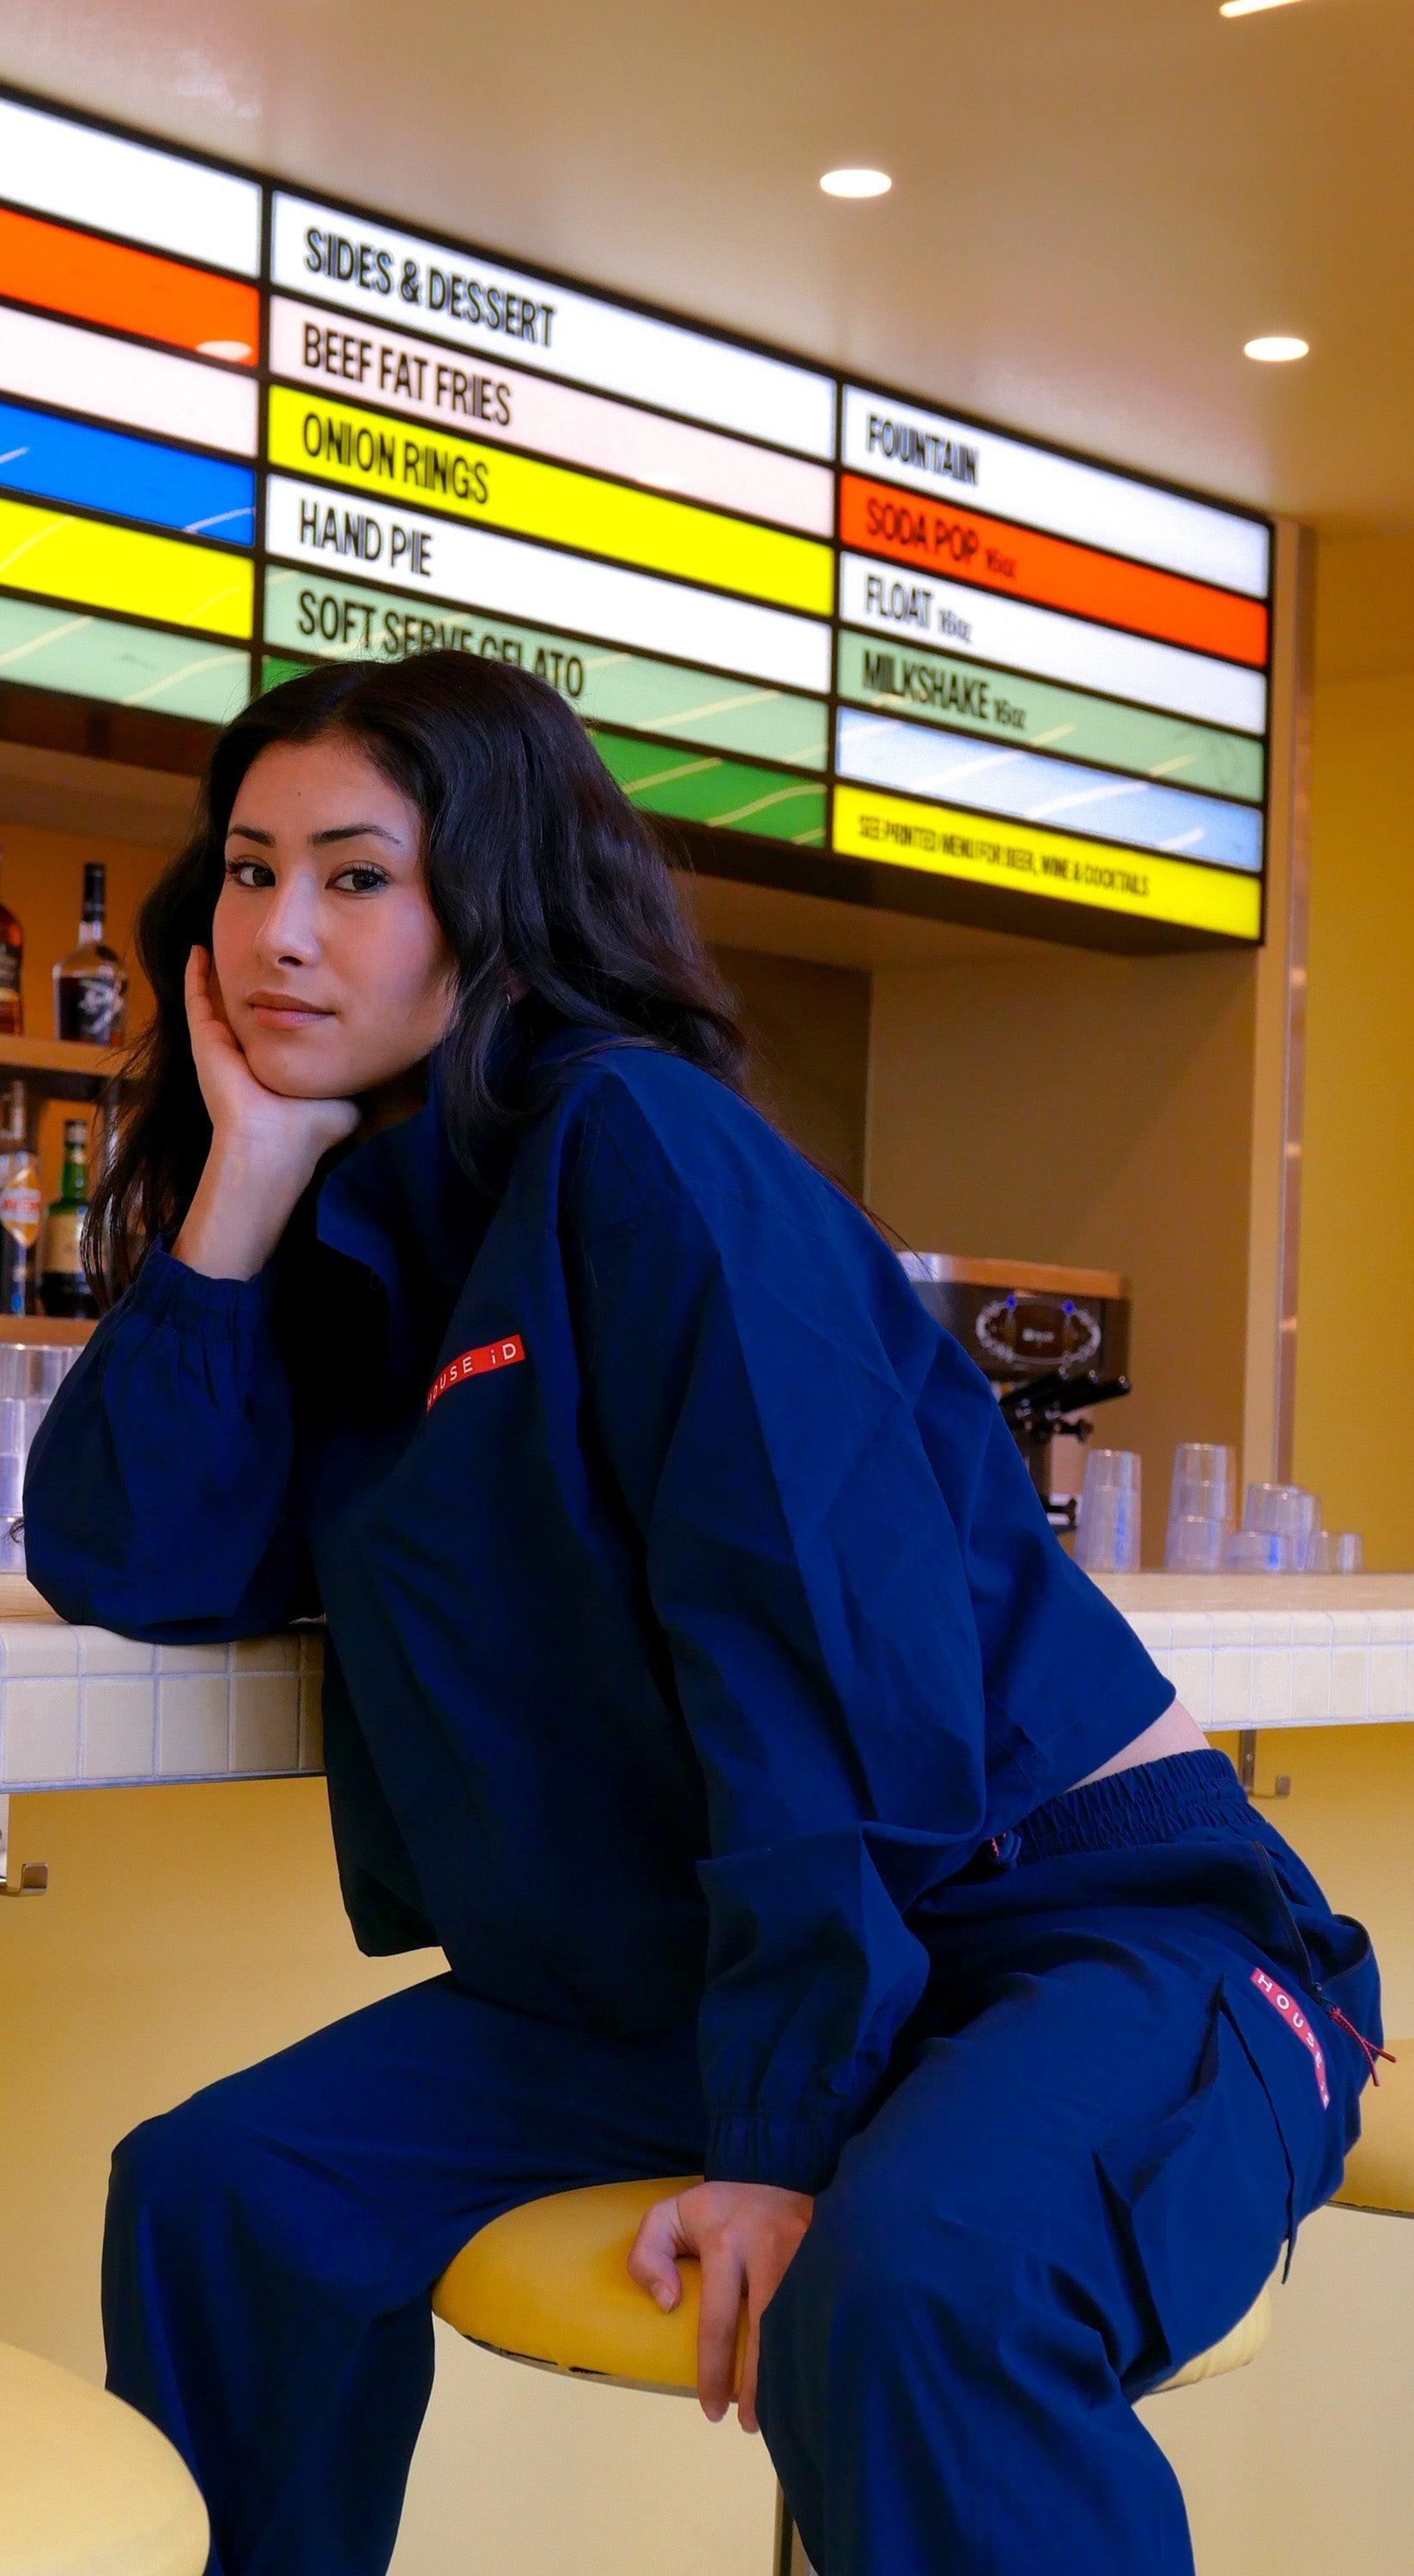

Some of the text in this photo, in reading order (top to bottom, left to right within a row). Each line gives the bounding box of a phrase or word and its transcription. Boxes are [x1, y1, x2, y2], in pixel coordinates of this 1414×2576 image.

[306, 227, 555, 347] SIDES & DESSERT
[303, 321, 511, 426] BEEF FAT FRIES
[303, 412, 489, 504] ONION RINGS
[867, 413, 979, 486] FOUNTAIN
[300, 498, 433, 577] HAND PIE
[867, 497, 928, 552] SODA
[934, 518, 979, 564] POP
[298, 589, 375, 650] SOFT
[866, 573, 933, 628] FLOAT
[864, 648, 991, 721] MILKSHAKE
[427, 1343, 517, 1413] HOUSE iD
[1258, 1974, 1322, 2069] HOUSE
